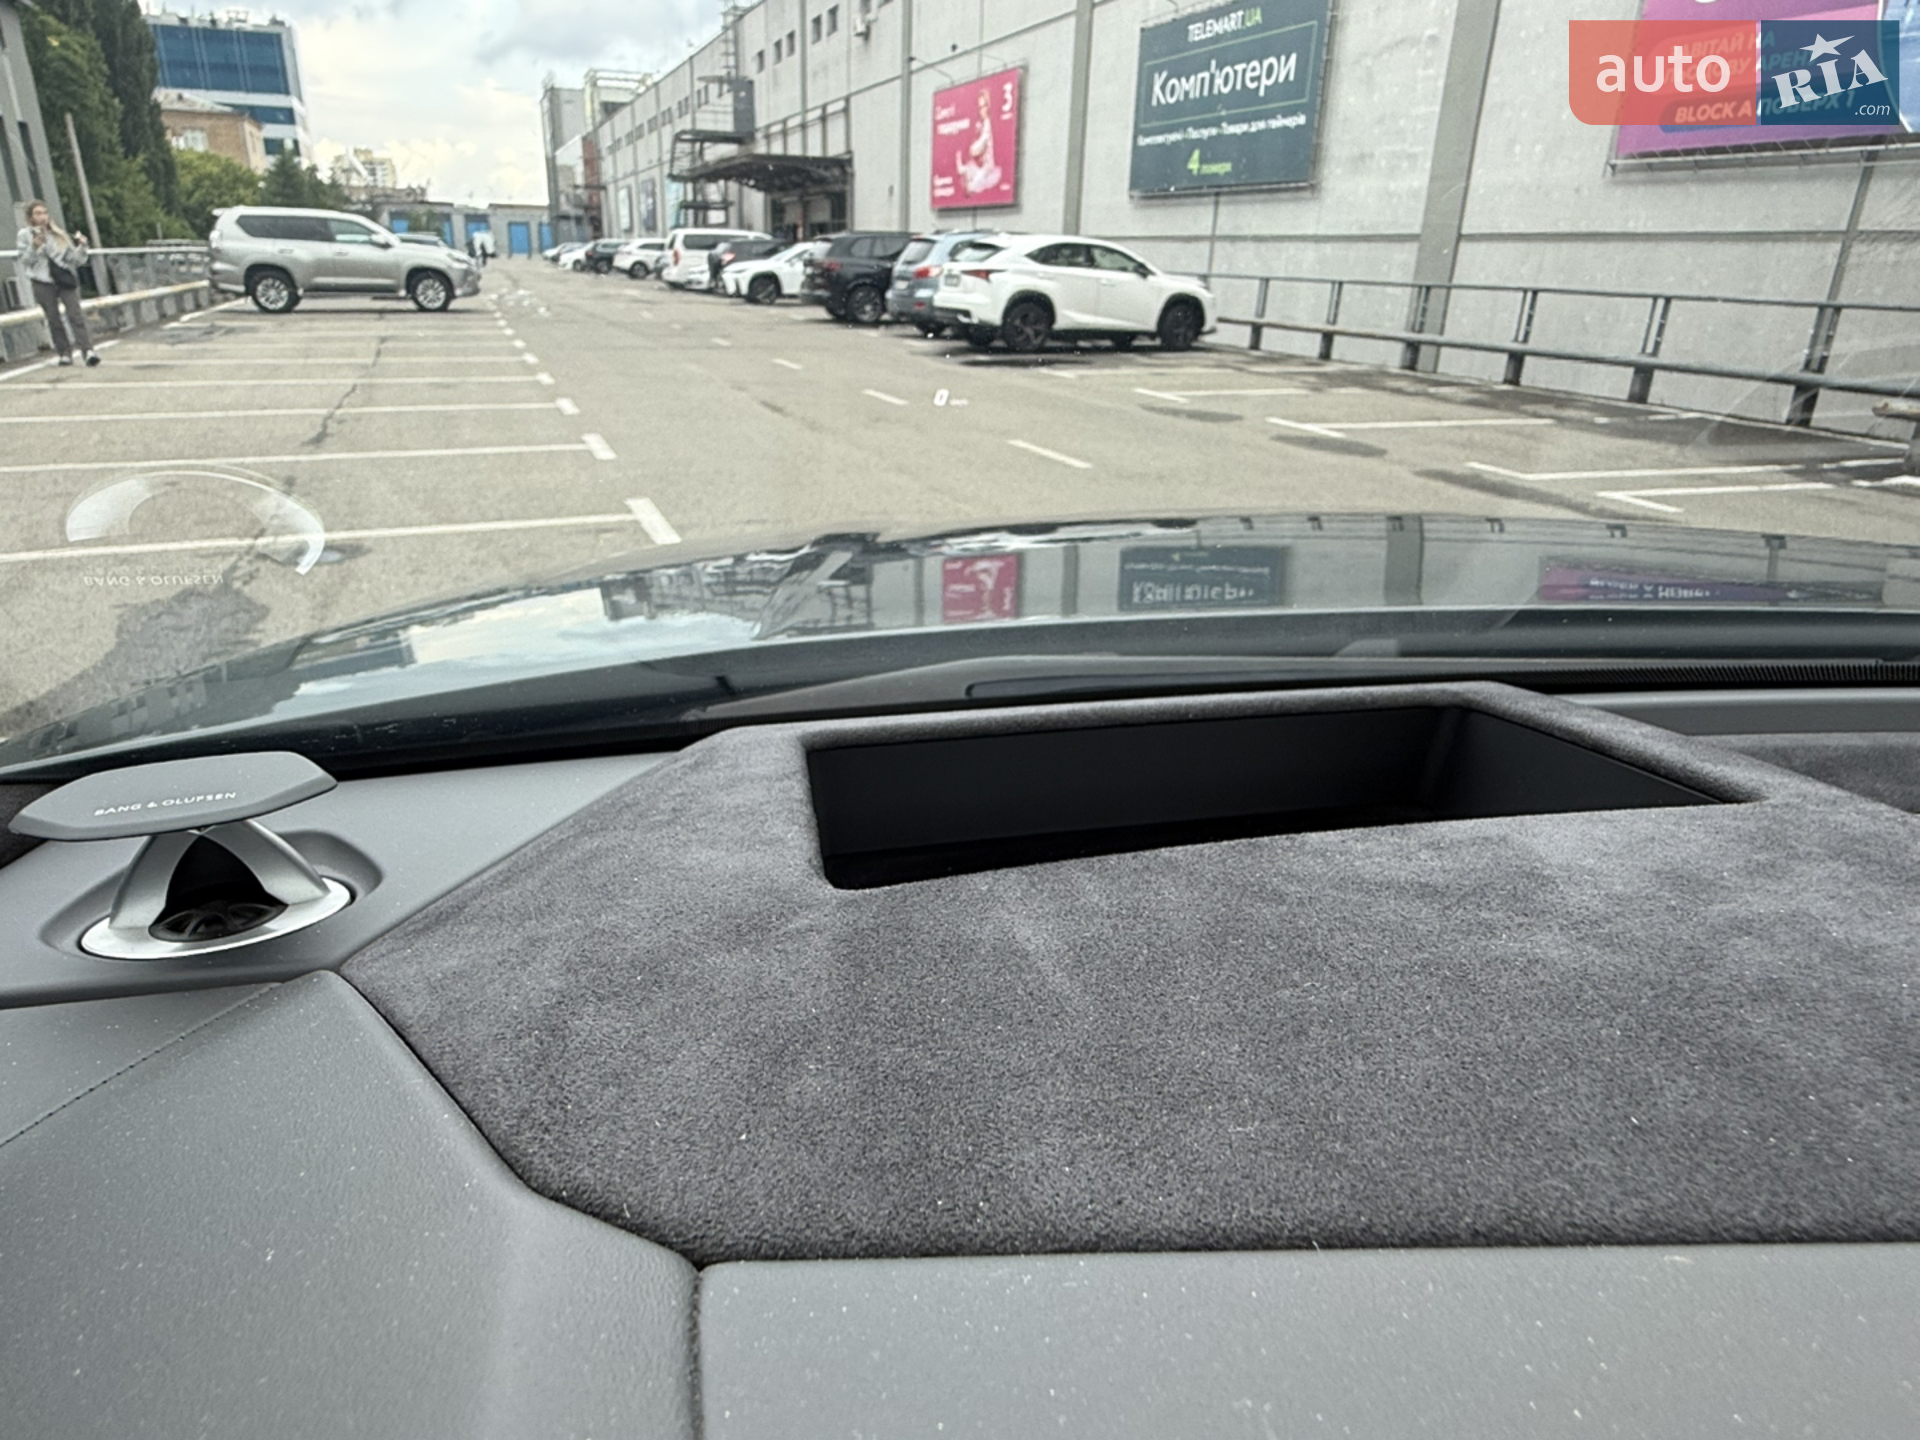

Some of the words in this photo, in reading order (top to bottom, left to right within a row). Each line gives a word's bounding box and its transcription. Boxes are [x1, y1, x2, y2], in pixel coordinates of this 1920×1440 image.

[1187, 7, 1262, 43] TELEMART.UA
[1151, 53, 1297, 107] Комп'ютери
[1674, 101, 1737, 124] BLOCK
[1187, 149, 1200, 176] 4
[94, 803, 142, 816] BANG
[162, 792, 236, 806] OLUFSEN
